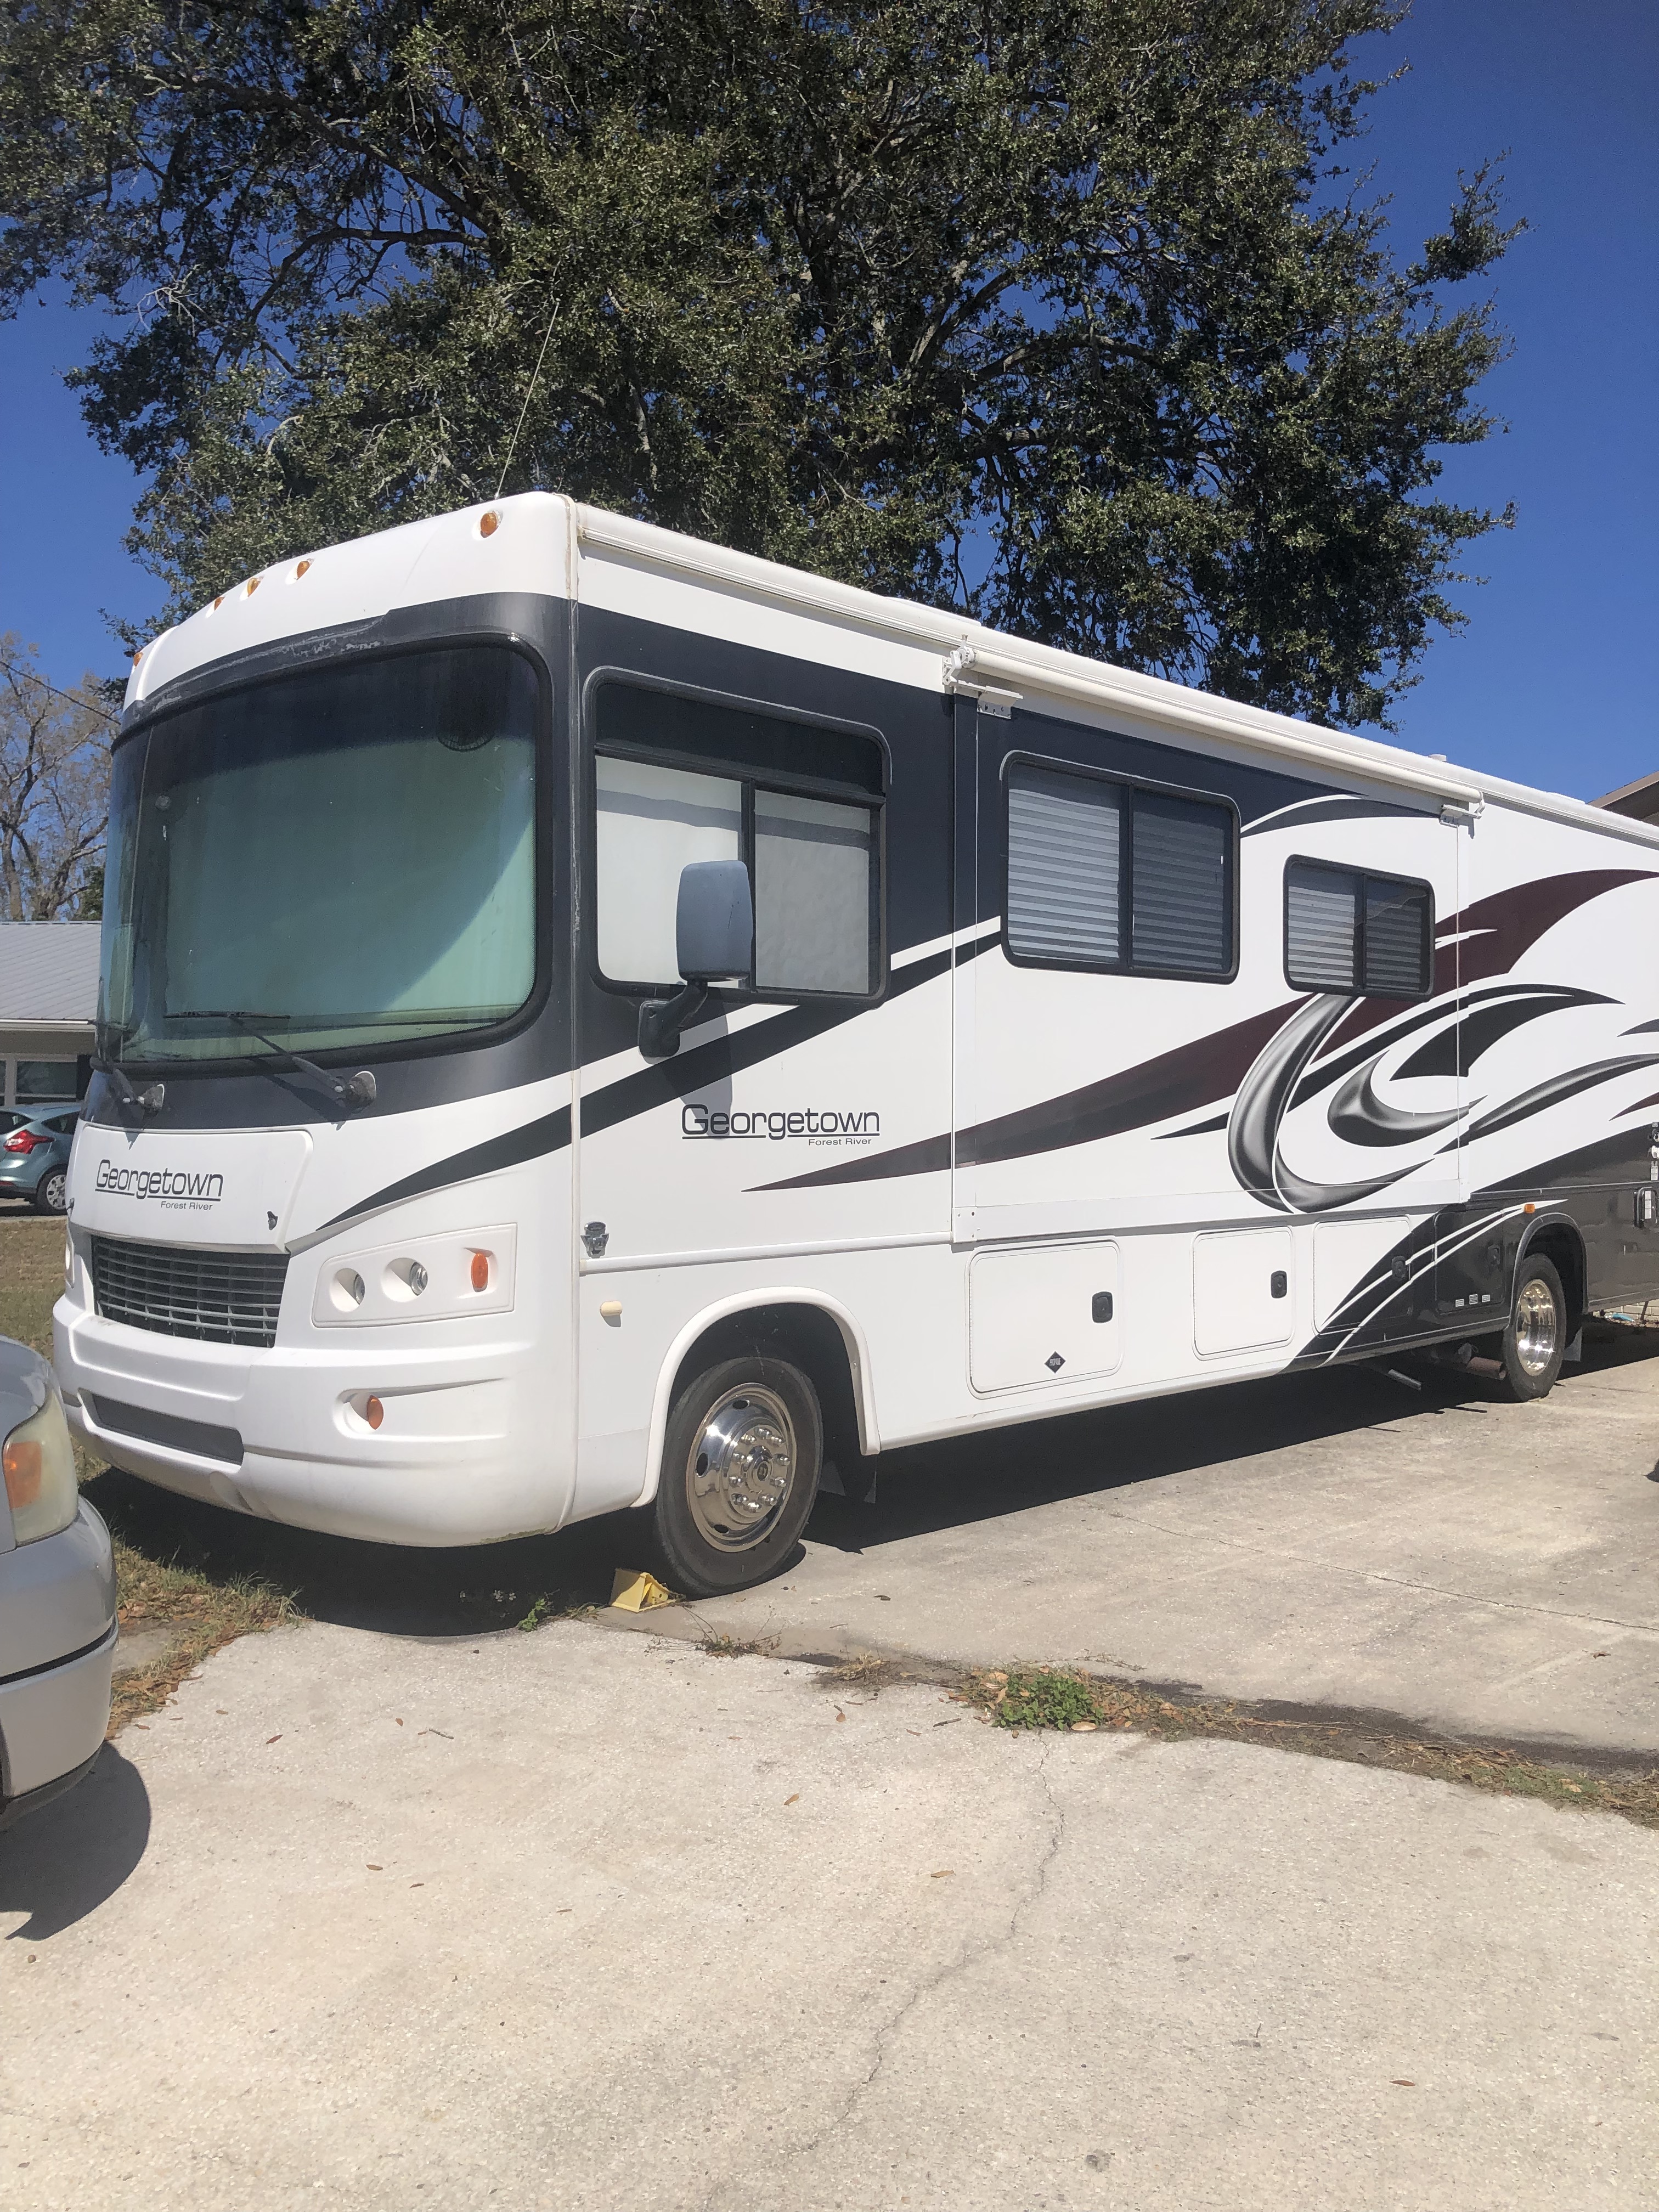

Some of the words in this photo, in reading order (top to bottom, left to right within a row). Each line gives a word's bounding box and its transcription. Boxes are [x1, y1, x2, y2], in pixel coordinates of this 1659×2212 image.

[682, 1104, 879, 1140] Georgetown
[808, 1138, 842, 1146] Forest
[845, 1137, 872, 1146] River
[97, 1159, 223, 1199] Georgetown
[161, 1201, 187, 1210] Forest
[189, 1202, 213, 1210] River
